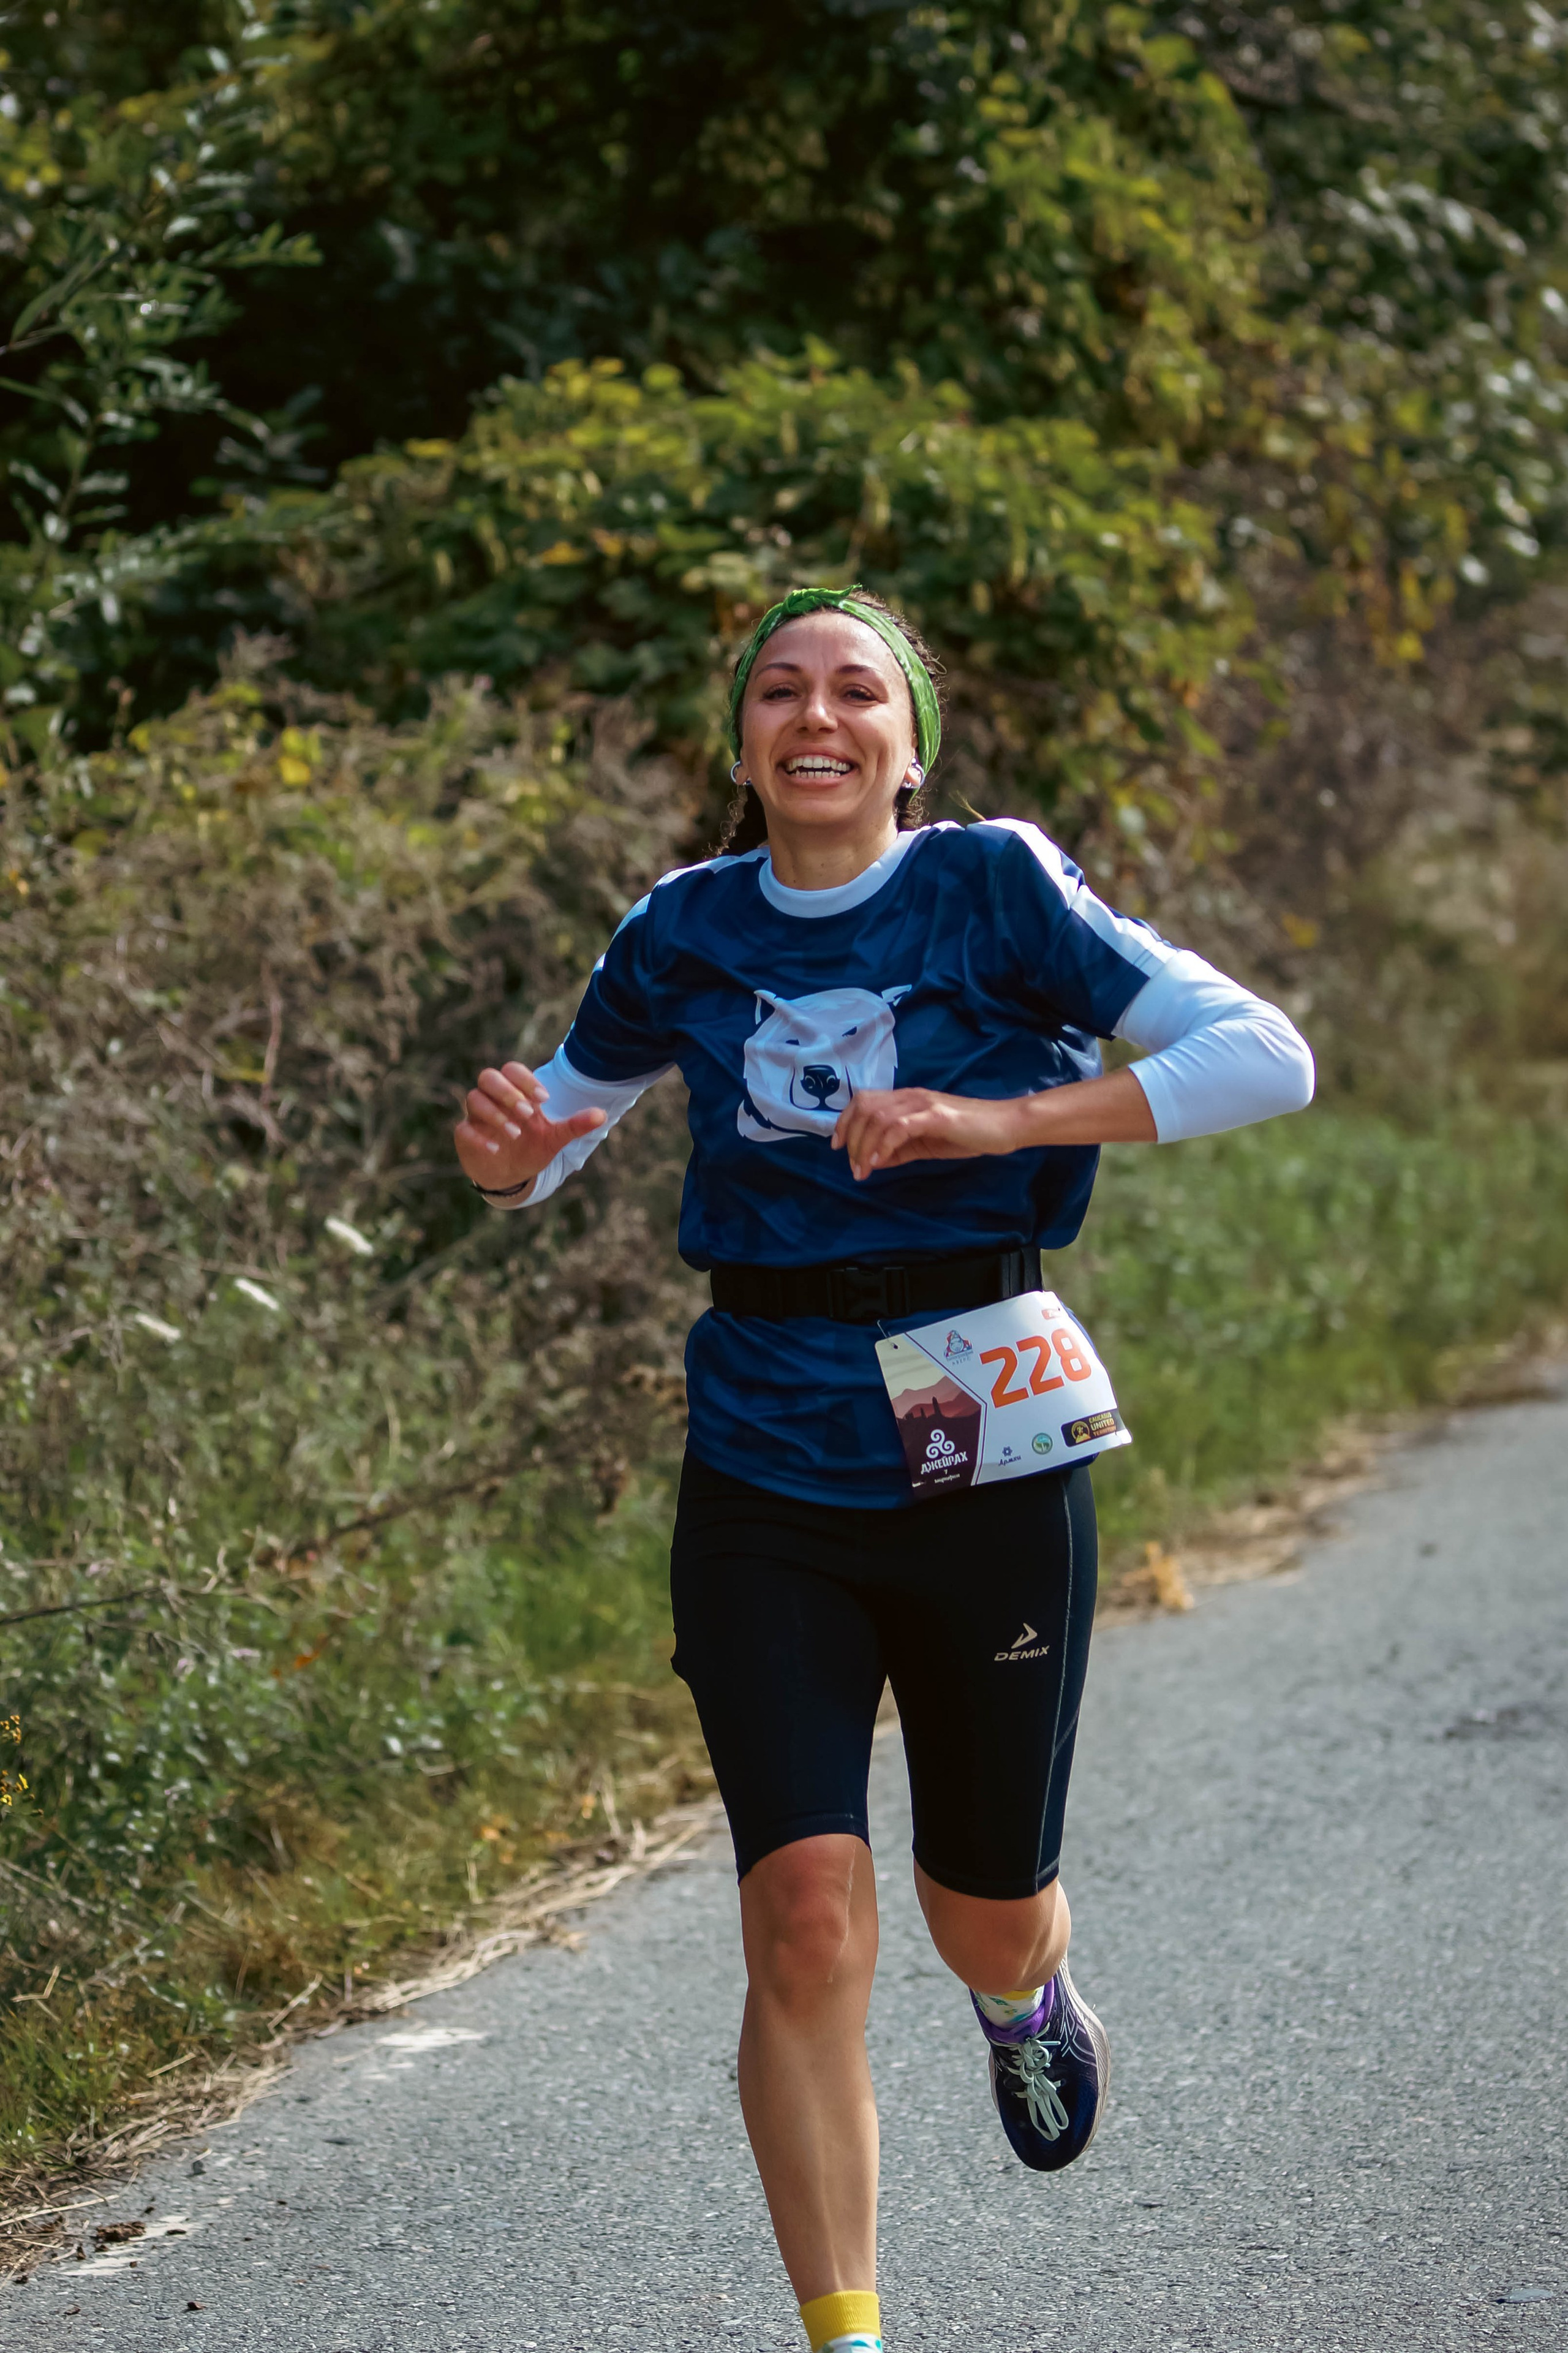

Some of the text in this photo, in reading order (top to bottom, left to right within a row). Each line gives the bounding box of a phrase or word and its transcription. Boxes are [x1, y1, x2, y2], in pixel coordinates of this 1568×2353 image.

[979, 1328, 1091, 1409] 228
[1090, 1418, 1115, 1431] UNITED
[921, 1451, 968, 1475] ДЖЕЙРАХ
[994, 1645, 1050, 1661] DEMIX
